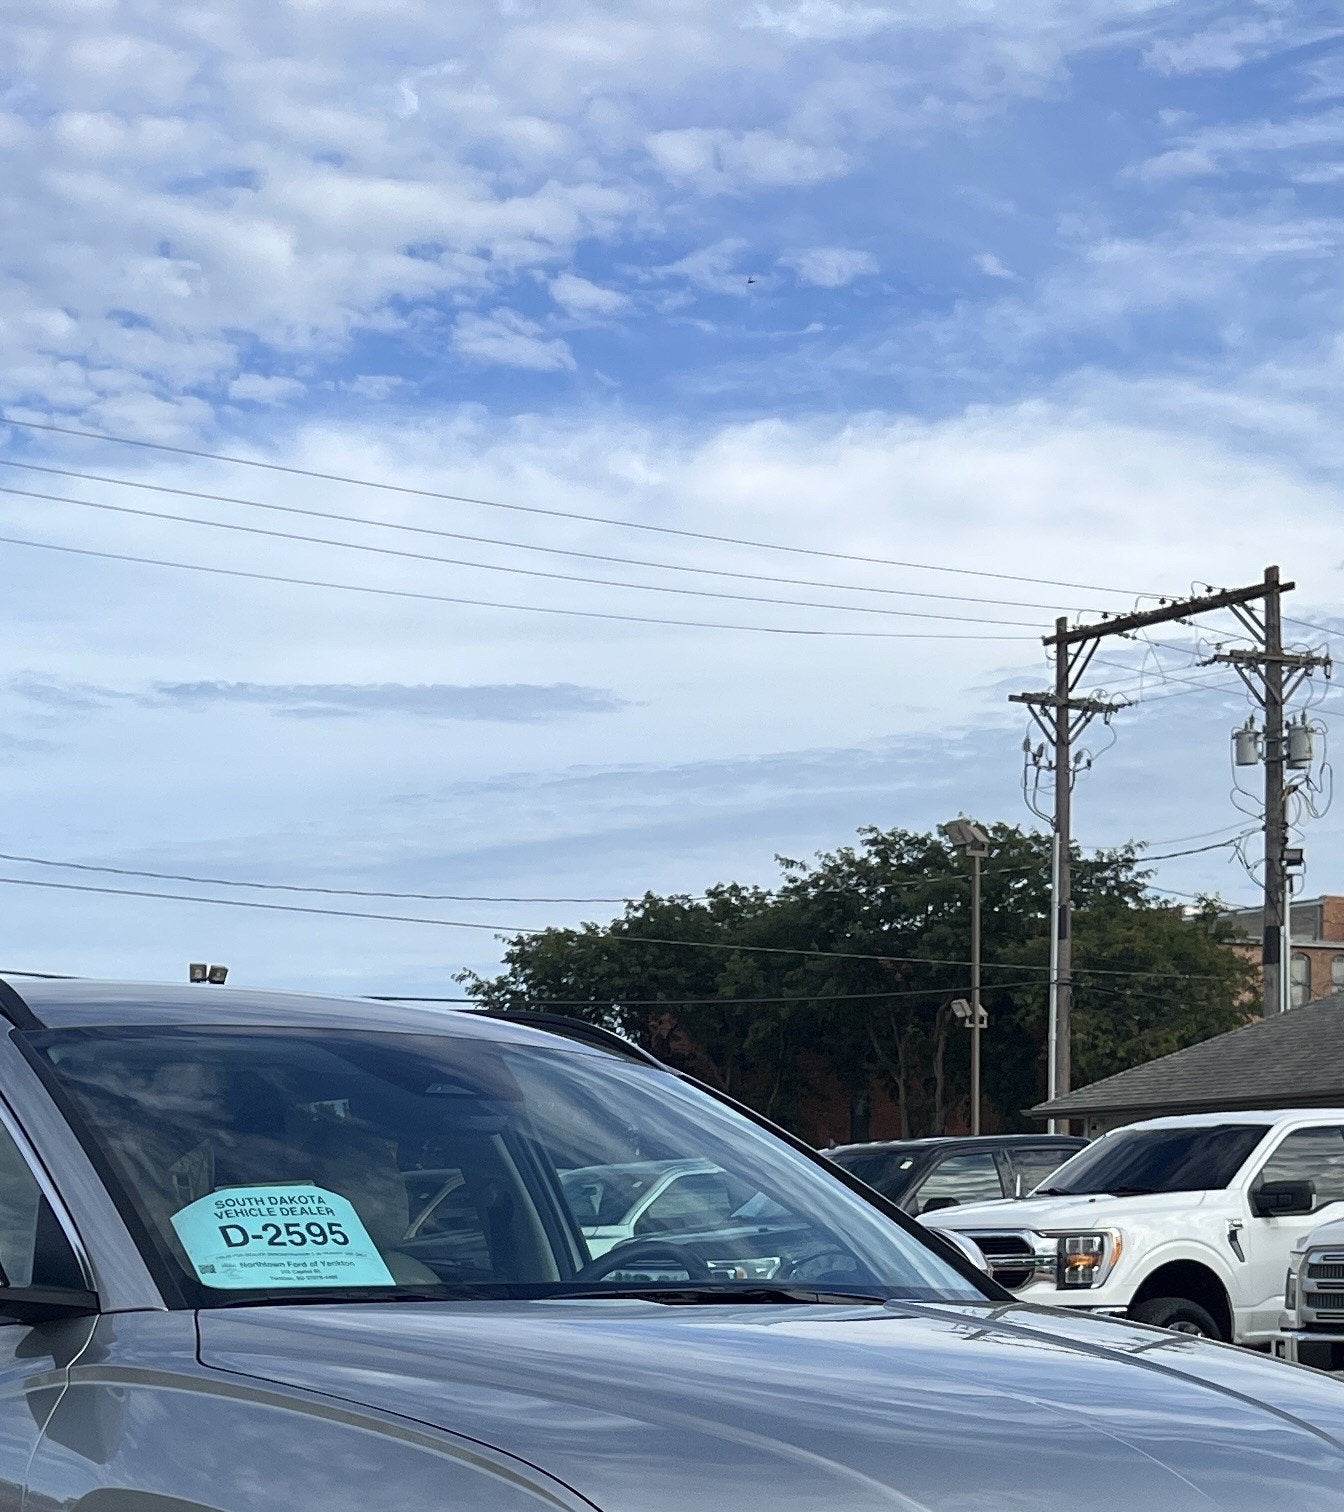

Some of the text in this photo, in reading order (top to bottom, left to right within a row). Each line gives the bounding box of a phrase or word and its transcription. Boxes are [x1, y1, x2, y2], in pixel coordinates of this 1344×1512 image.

[214, 1195, 327, 1209] SOUTH DAKOTA
[214, 1206, 336, 1220] VEHICLE DEALER
[218, 1222, 350, 1248] D-2595
[286, 1260, 308, 1268] Ford
